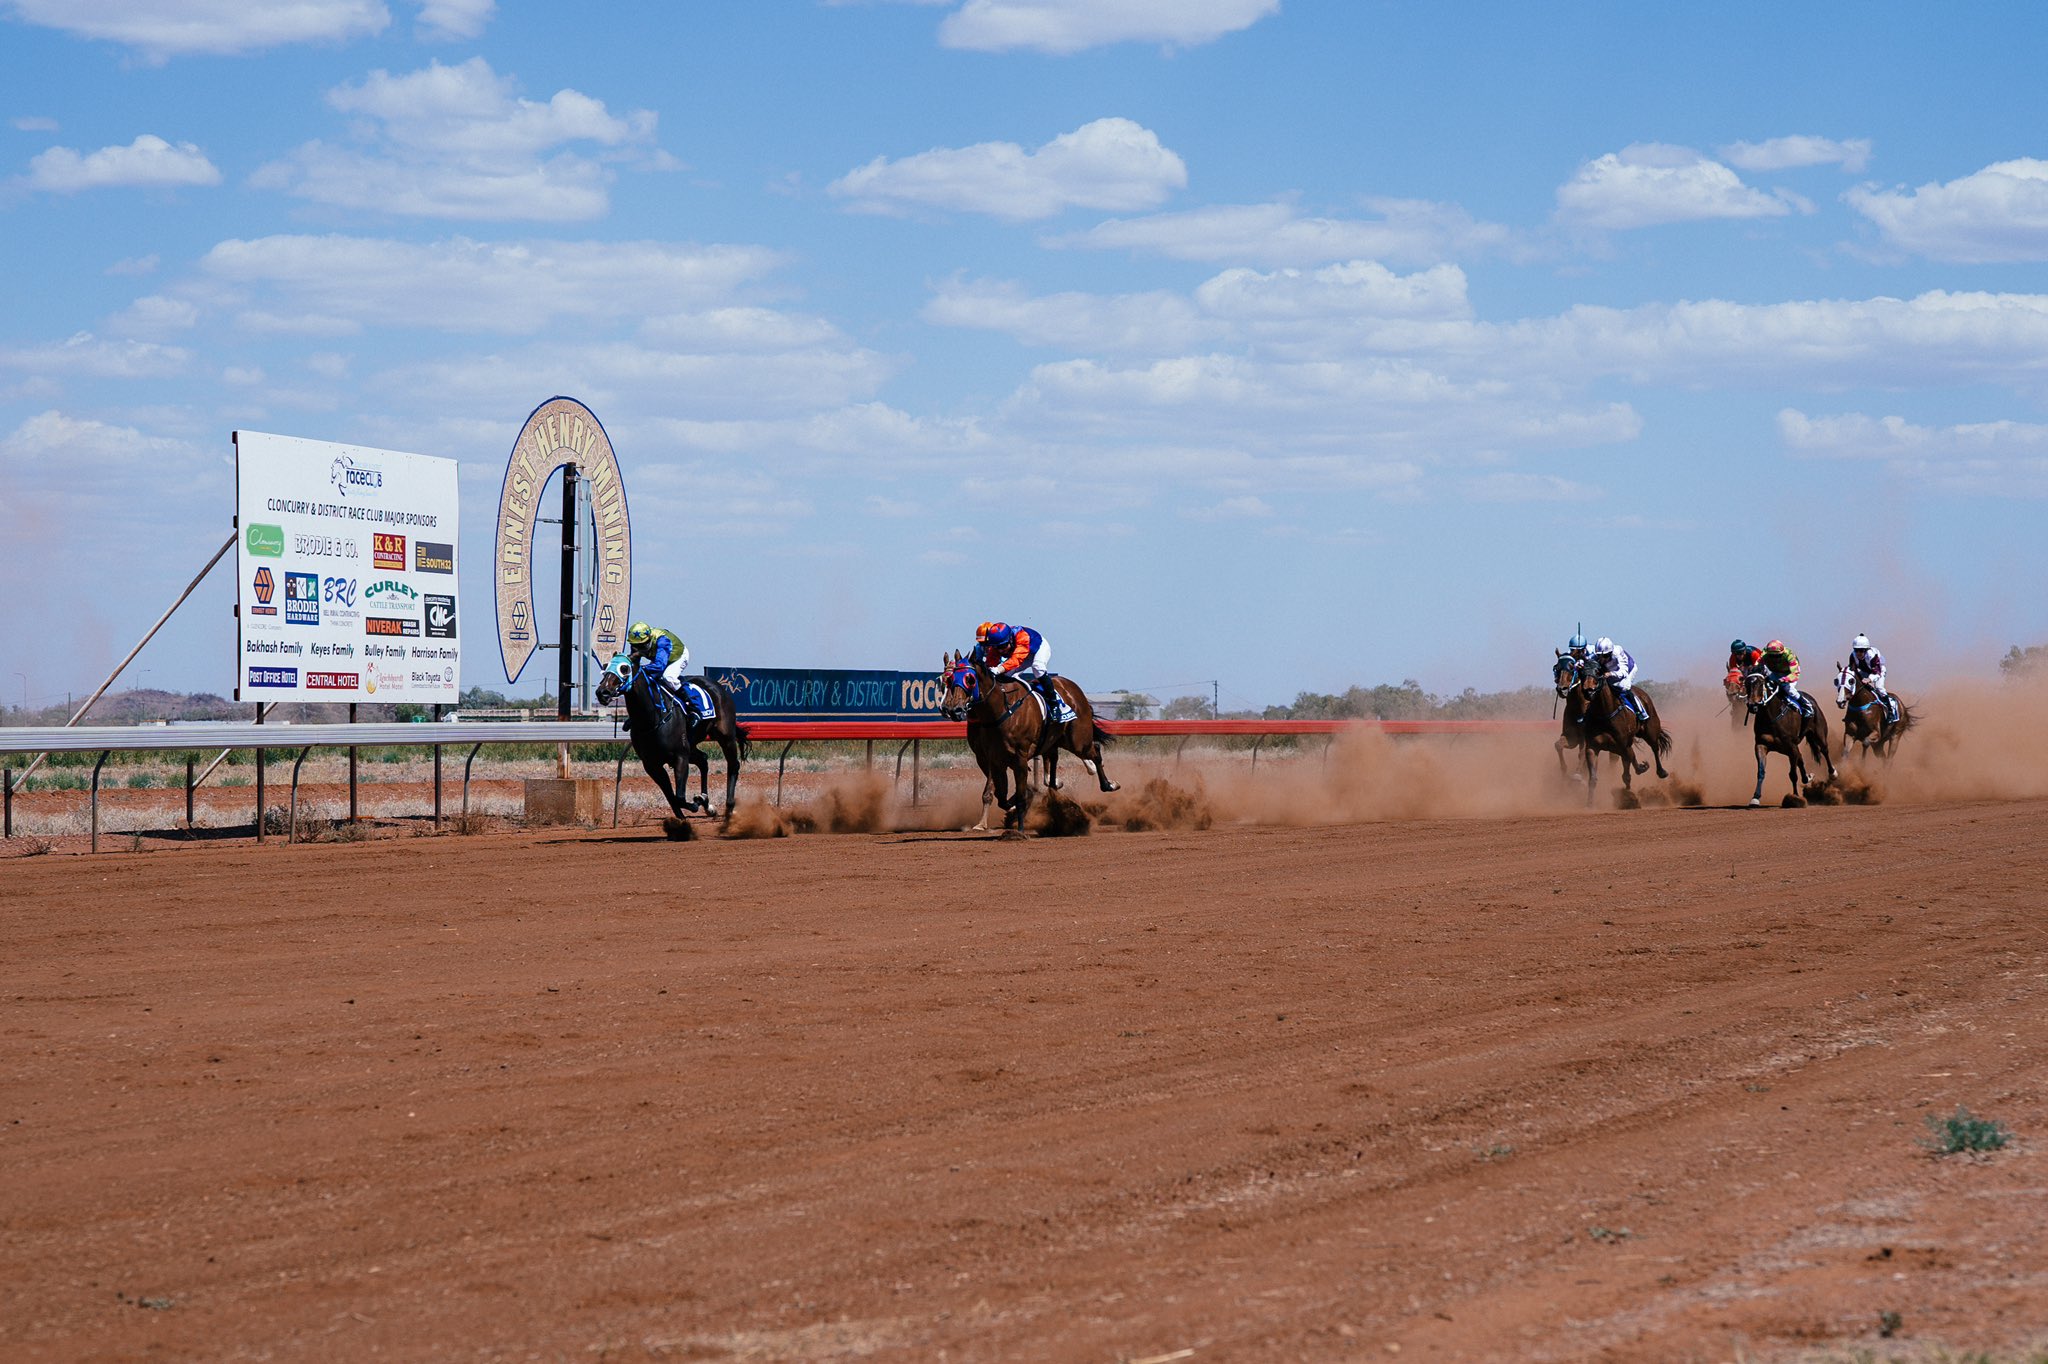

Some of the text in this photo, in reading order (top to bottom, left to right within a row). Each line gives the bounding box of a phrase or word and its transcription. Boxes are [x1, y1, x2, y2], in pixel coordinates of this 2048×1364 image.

[534, 412, 597, 461] HENRY
[268, 498, 437, 527] CLONCURRY & DISTRICT RACE CLUB MAJOR SPONSORS
[503, 449, 537, 585] ERNEST
[592, 456, 624, 585] MINING
[295, 534, 332, 556] BRODIE
[345, 538, 358, 558] CO.
[374, 535, 403, 553] K & R
[426, 557, 452, 570] SOUTH32
[323, 576, 358, 608] BRC
[365, 580, 418, 600] CURLEY
[287, 600, 318, 613] BRODIE
[369, 601, 415, 610] CATTLE TRANSPORT
[287, 613, 318, 621] HARDWARE
[367, 620, 402, 634] NIVERAK
[246, 640, 303, 657] Bakhash Family
[310, 643, 354, 659] Keyes Family
[365, 645, 406, 660] Bulley Family
[412, 647, 458, 662] Harrison Family
[250, 671, 296, 683] POST OFFICE HOTEL
[307, 674, 359, 687] CENTRAL HOTEL
[412, 672, 440, 683] Black Toyota
[750, 679, 828, 706] CLONCURRY
[831, 681, 842, 706] &
[845, 680, 897, 706] DISTRICT
